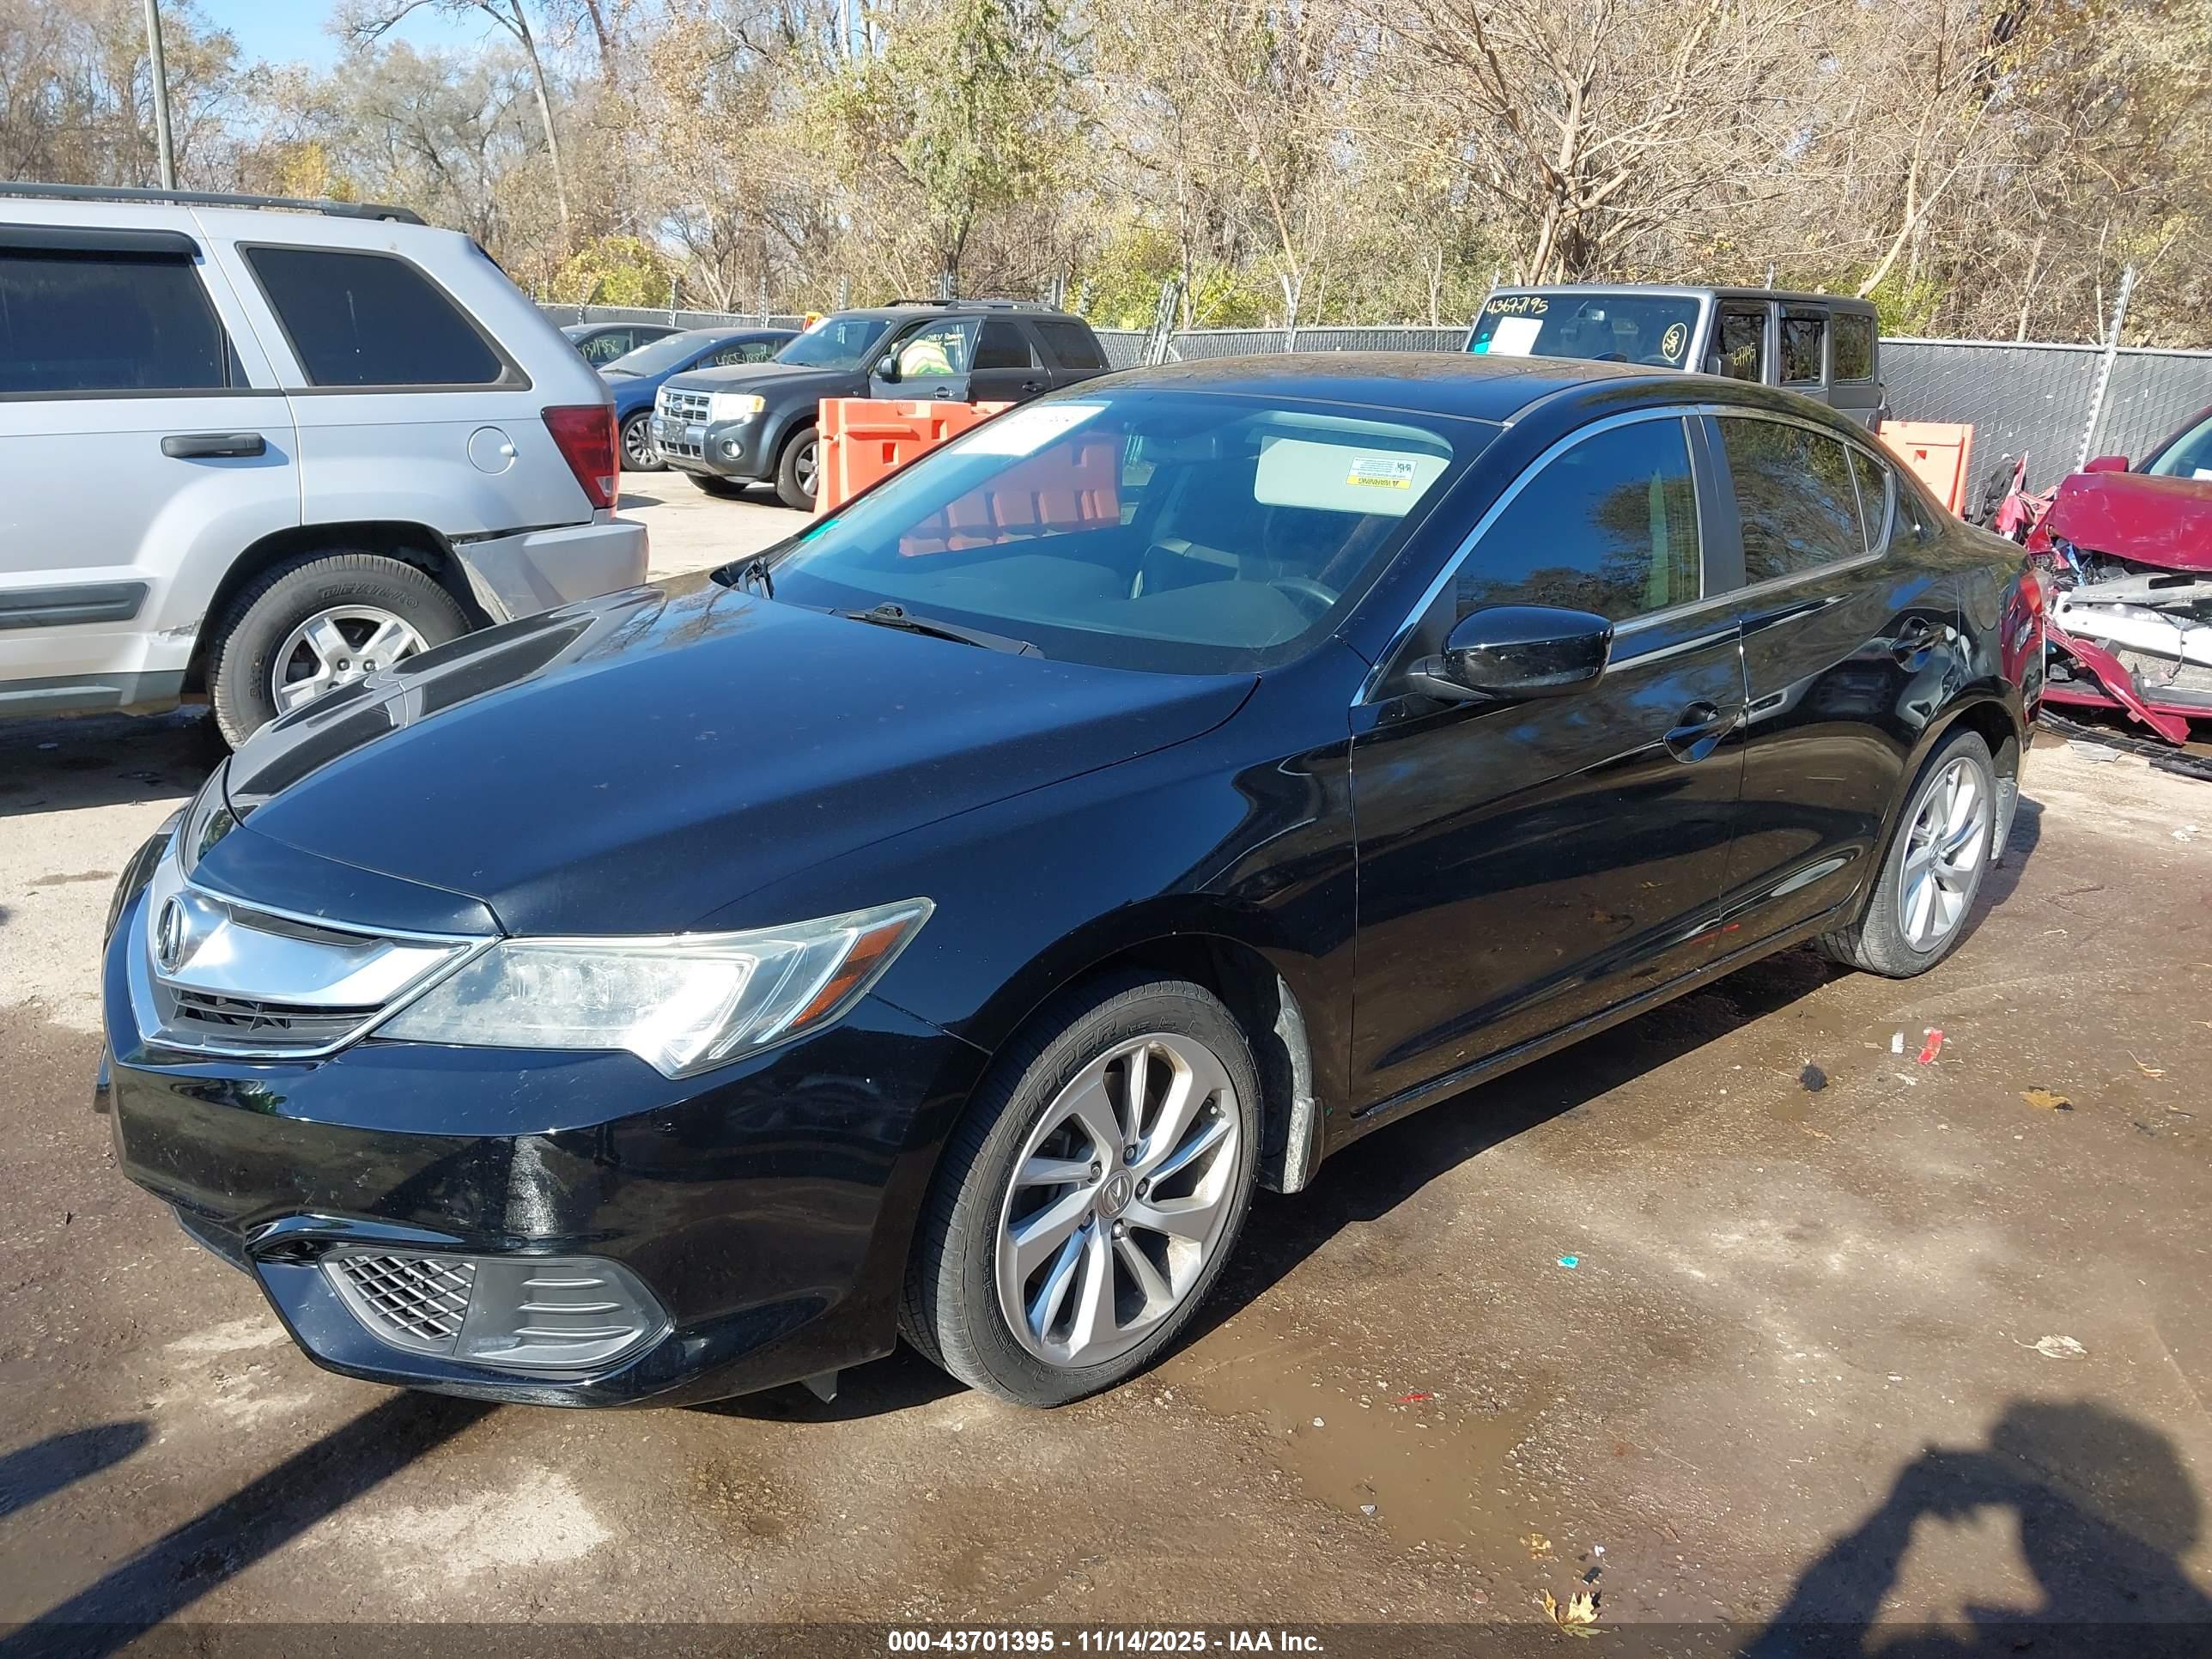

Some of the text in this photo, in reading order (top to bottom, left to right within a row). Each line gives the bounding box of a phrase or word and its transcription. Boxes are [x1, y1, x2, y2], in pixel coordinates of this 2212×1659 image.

[1486, 296, 1548, 315] 43677195
[1357, 477, 1391, 488] WARNING
[1005, 1018, 1117, 1151] COOPER
